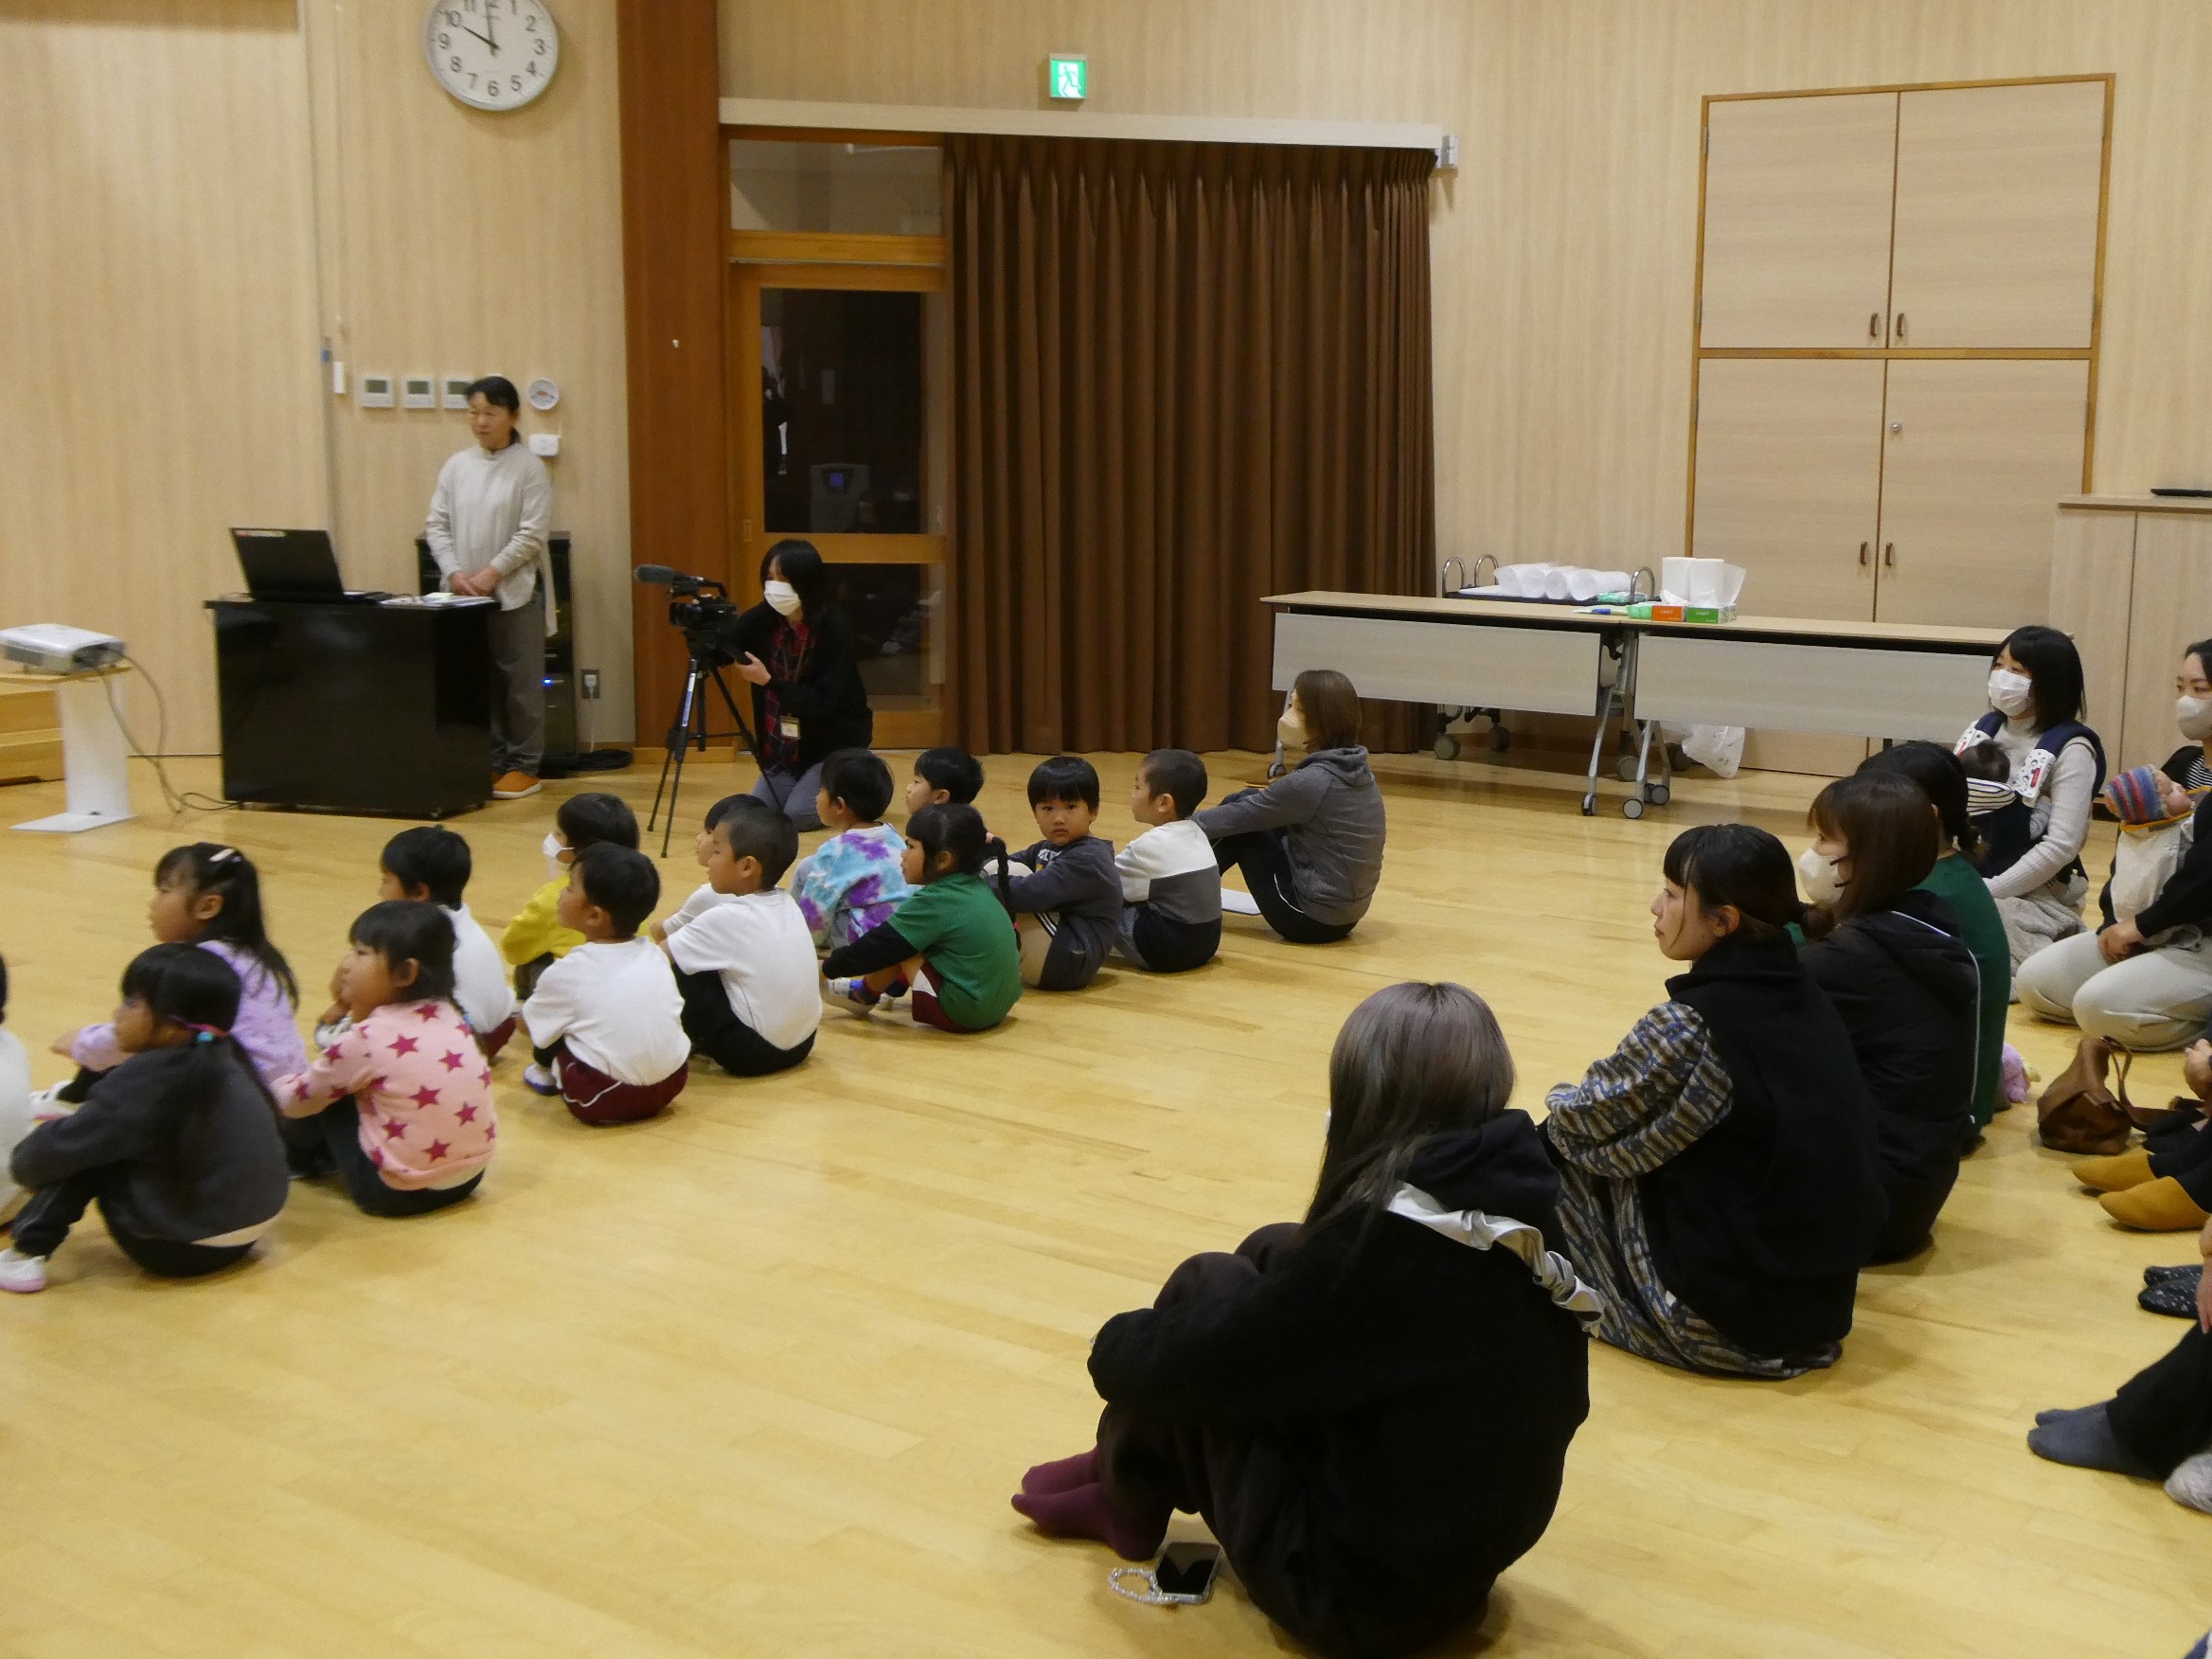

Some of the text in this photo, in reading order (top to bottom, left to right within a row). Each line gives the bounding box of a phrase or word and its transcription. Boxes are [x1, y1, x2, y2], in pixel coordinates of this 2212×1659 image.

[510, 0, 517, 15] 1
[445, 10, 462, 27] 10
[526, 15, 536, 32] 2
[438, 33, 451, 49] 9
[534, 39, 545, 55] 3
[450, 56, 462, 73] 8
[526, 61, 536, 76] 4
[467, 72, 478, 89] 7
[487, 80, 499, 97] 6
[510, 75, 522, 92] 5
